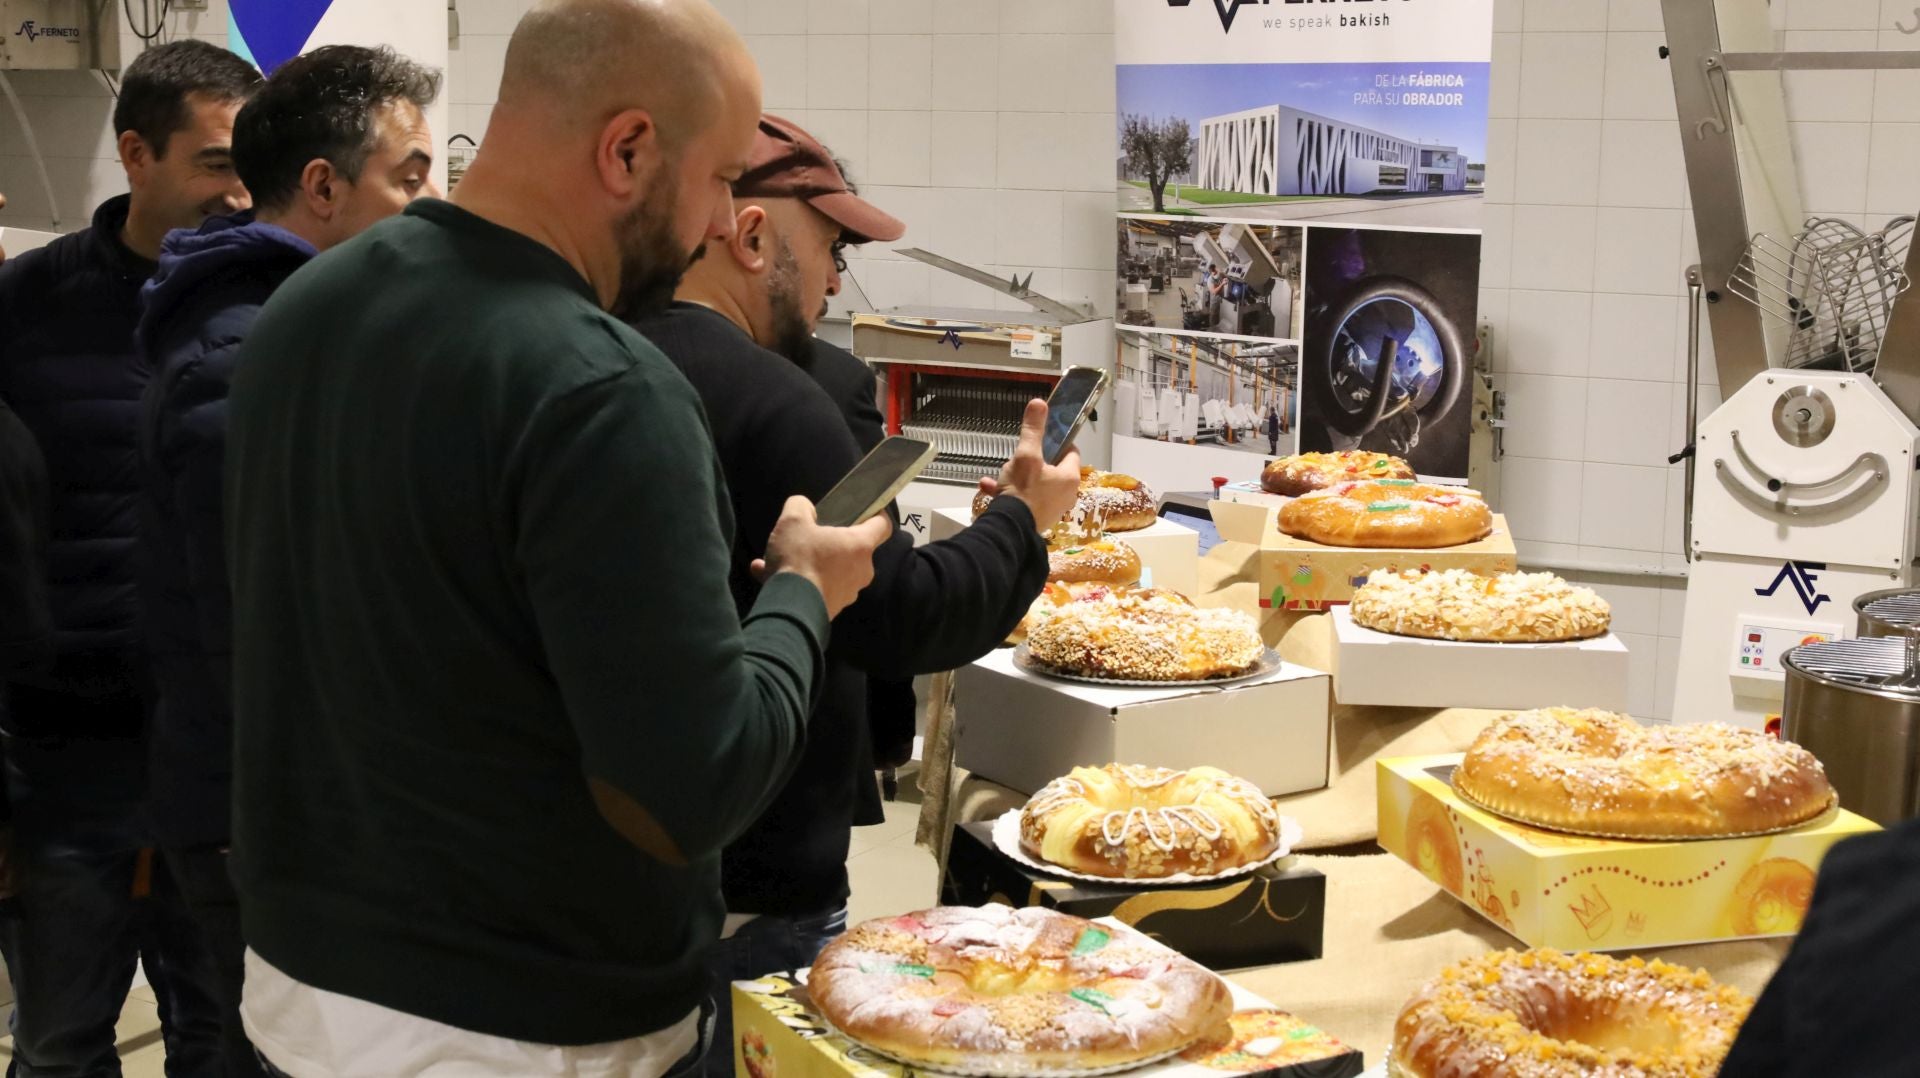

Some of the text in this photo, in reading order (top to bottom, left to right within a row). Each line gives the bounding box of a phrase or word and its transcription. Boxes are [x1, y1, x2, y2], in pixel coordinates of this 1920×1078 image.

[1263, 13, 1390, 32] we speak bakish
[41, 28, 80, 37] FERNETO
[1375, 70, 1464, 87] DE LA FÁBRICA
[1353, 92, 1463, 106] PARA SU OBRADOR
